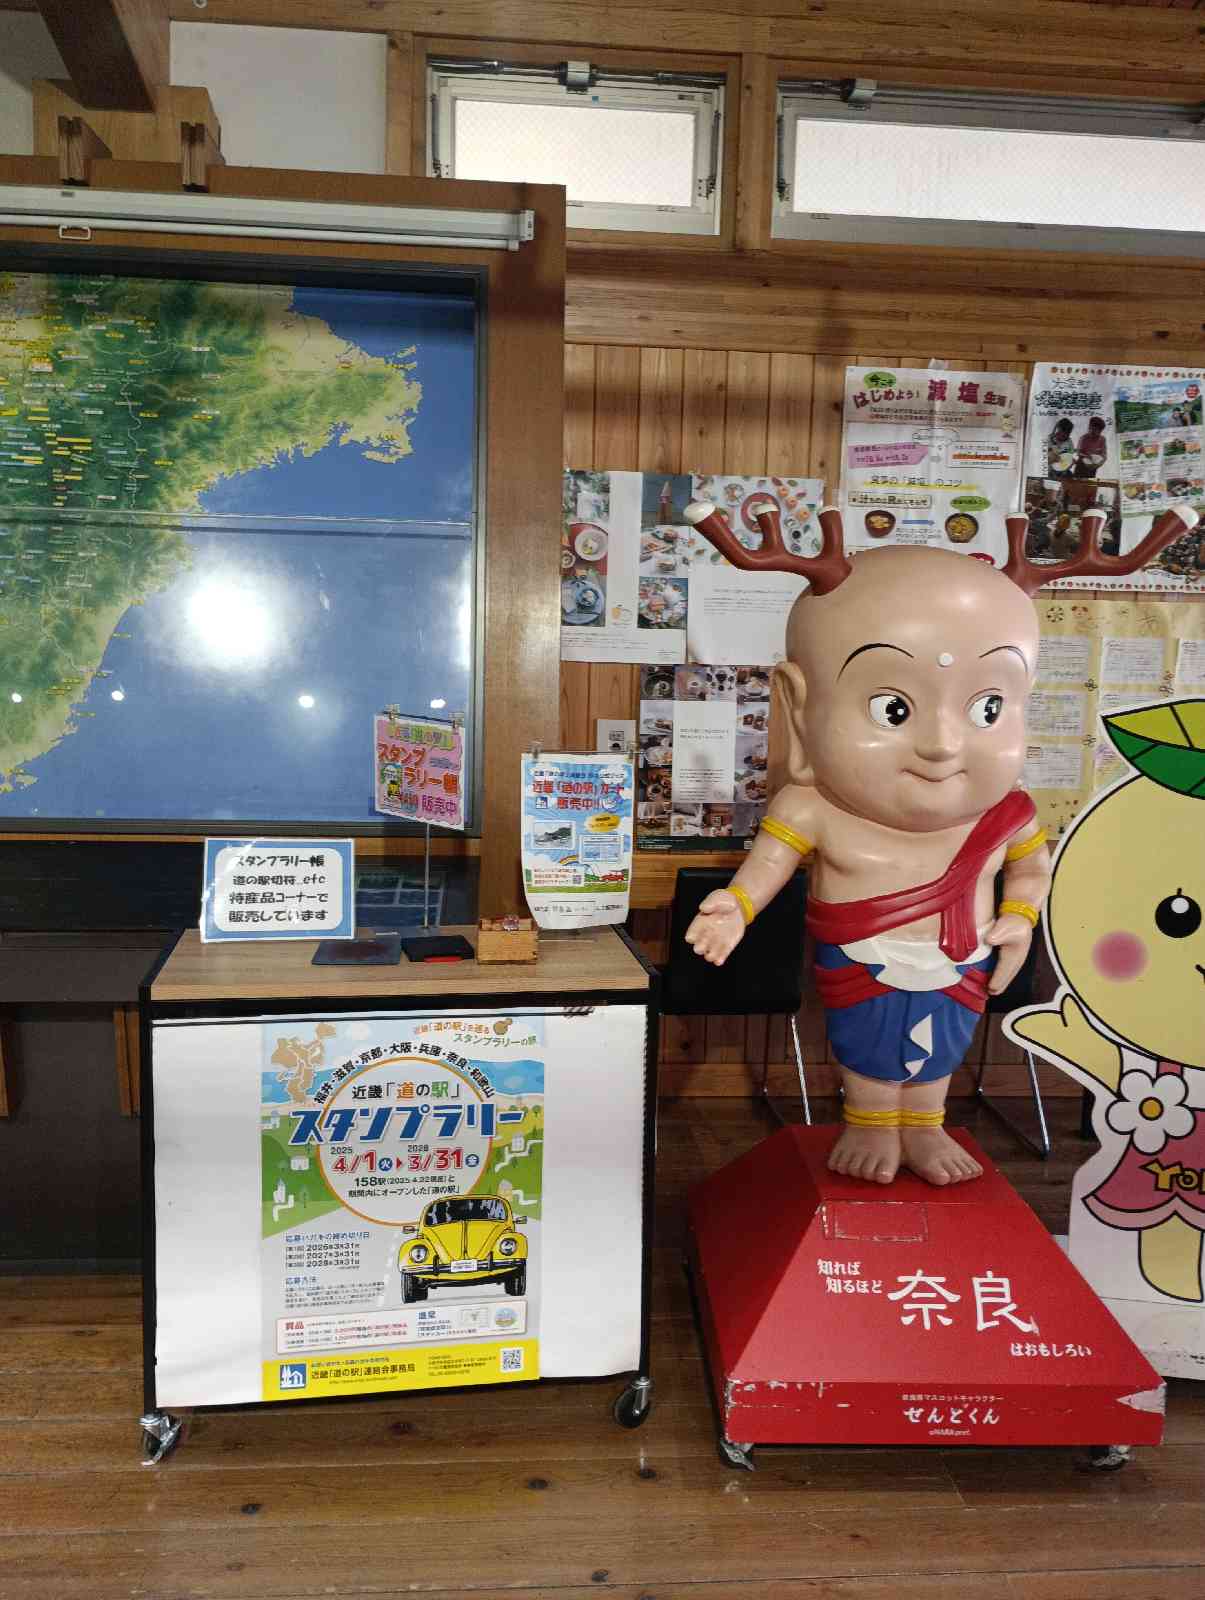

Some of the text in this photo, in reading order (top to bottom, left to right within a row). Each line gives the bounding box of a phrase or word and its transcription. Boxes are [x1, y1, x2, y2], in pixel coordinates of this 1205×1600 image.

[229, 891, 329, 905] 特産品コーナーで
[228, 909, 329, 923] 販売しています
[351, 1080, 461, 1100] 近畿「道の駅」
[288, 1102, 525, 1145] スタンプラリー
[330, 1146, 354, 1155] 2025
[1138, 1159, 1205, 1195] Yo
[816, 1258, 861, 1277] 知れば
[825, 1276, 884, 1295] 知るほど
[887, 1269, 1039, 1332] 奈良
[1010, 1342, 1092, 1358] はおもしろい
[903, 1406, 1000, 1424] せんとくん
